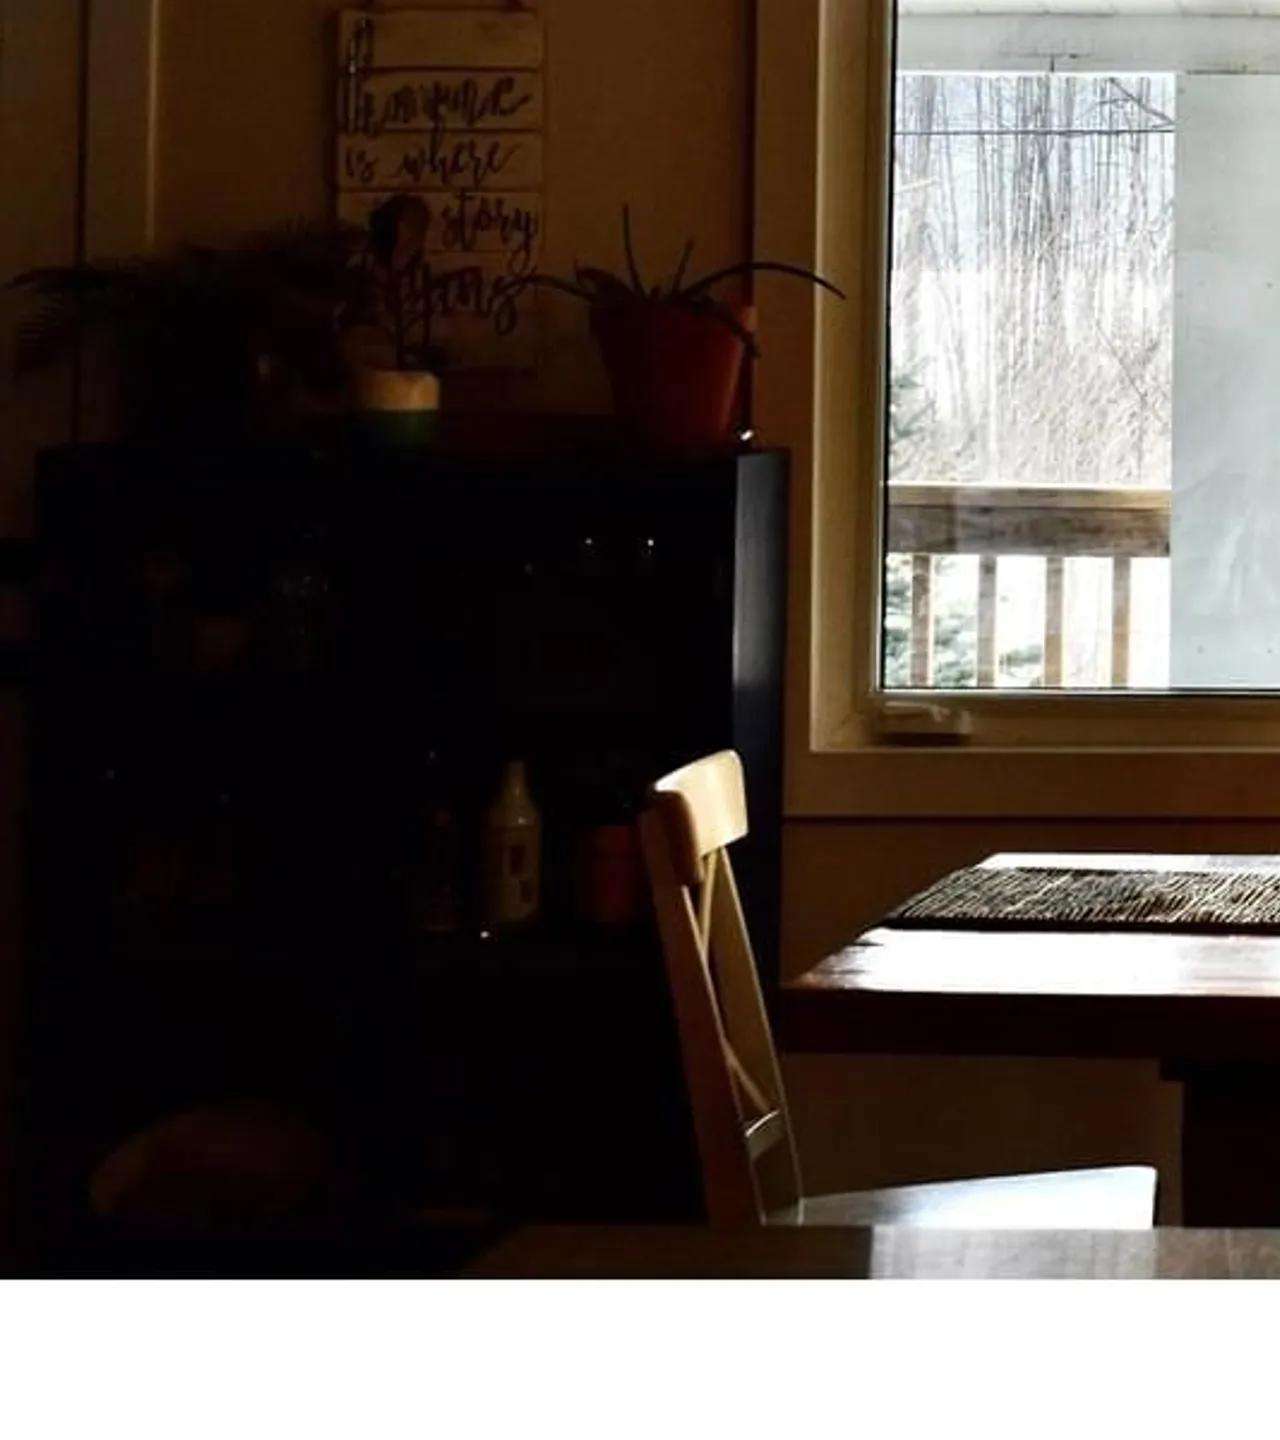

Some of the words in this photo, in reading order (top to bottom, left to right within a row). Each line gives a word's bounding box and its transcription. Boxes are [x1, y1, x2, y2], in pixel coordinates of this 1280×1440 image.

[345, 145, 381, 184] is
[387, 115, 524, 188] where
[440, 187, 539, 275] story
